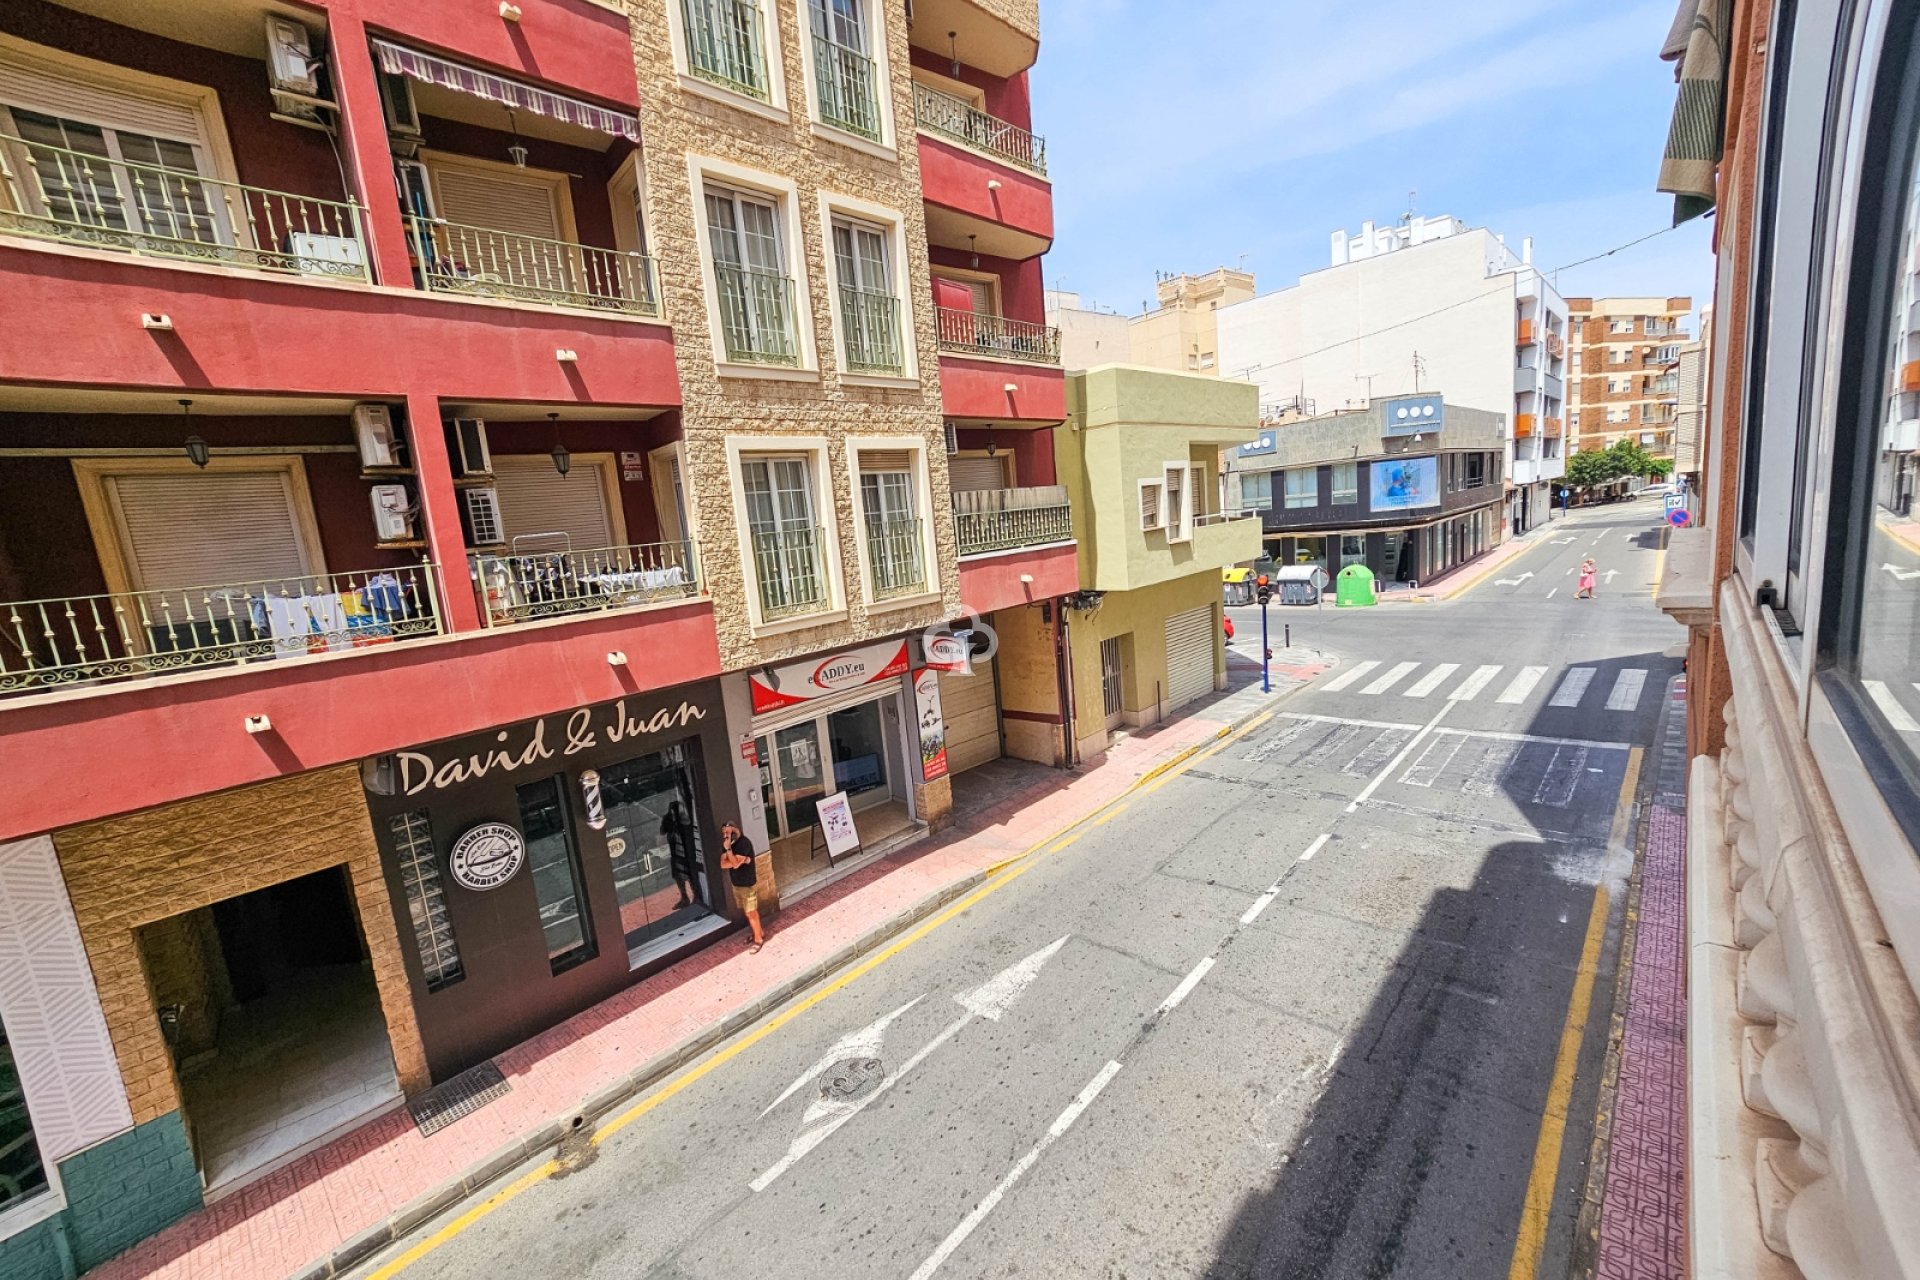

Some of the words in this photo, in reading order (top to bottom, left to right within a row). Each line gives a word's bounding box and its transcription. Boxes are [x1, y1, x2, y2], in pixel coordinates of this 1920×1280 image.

[396, 718, 555, 796] David
[563, 708, 597, 755] &
[606, 700, 707, 743] Juan
[456, 828, 489, 859] BARBER
[491, 827, 517, 841] SHOP
[462, 872, 499, 886] BARBER
[500, 855, 518, 878] SHOP
